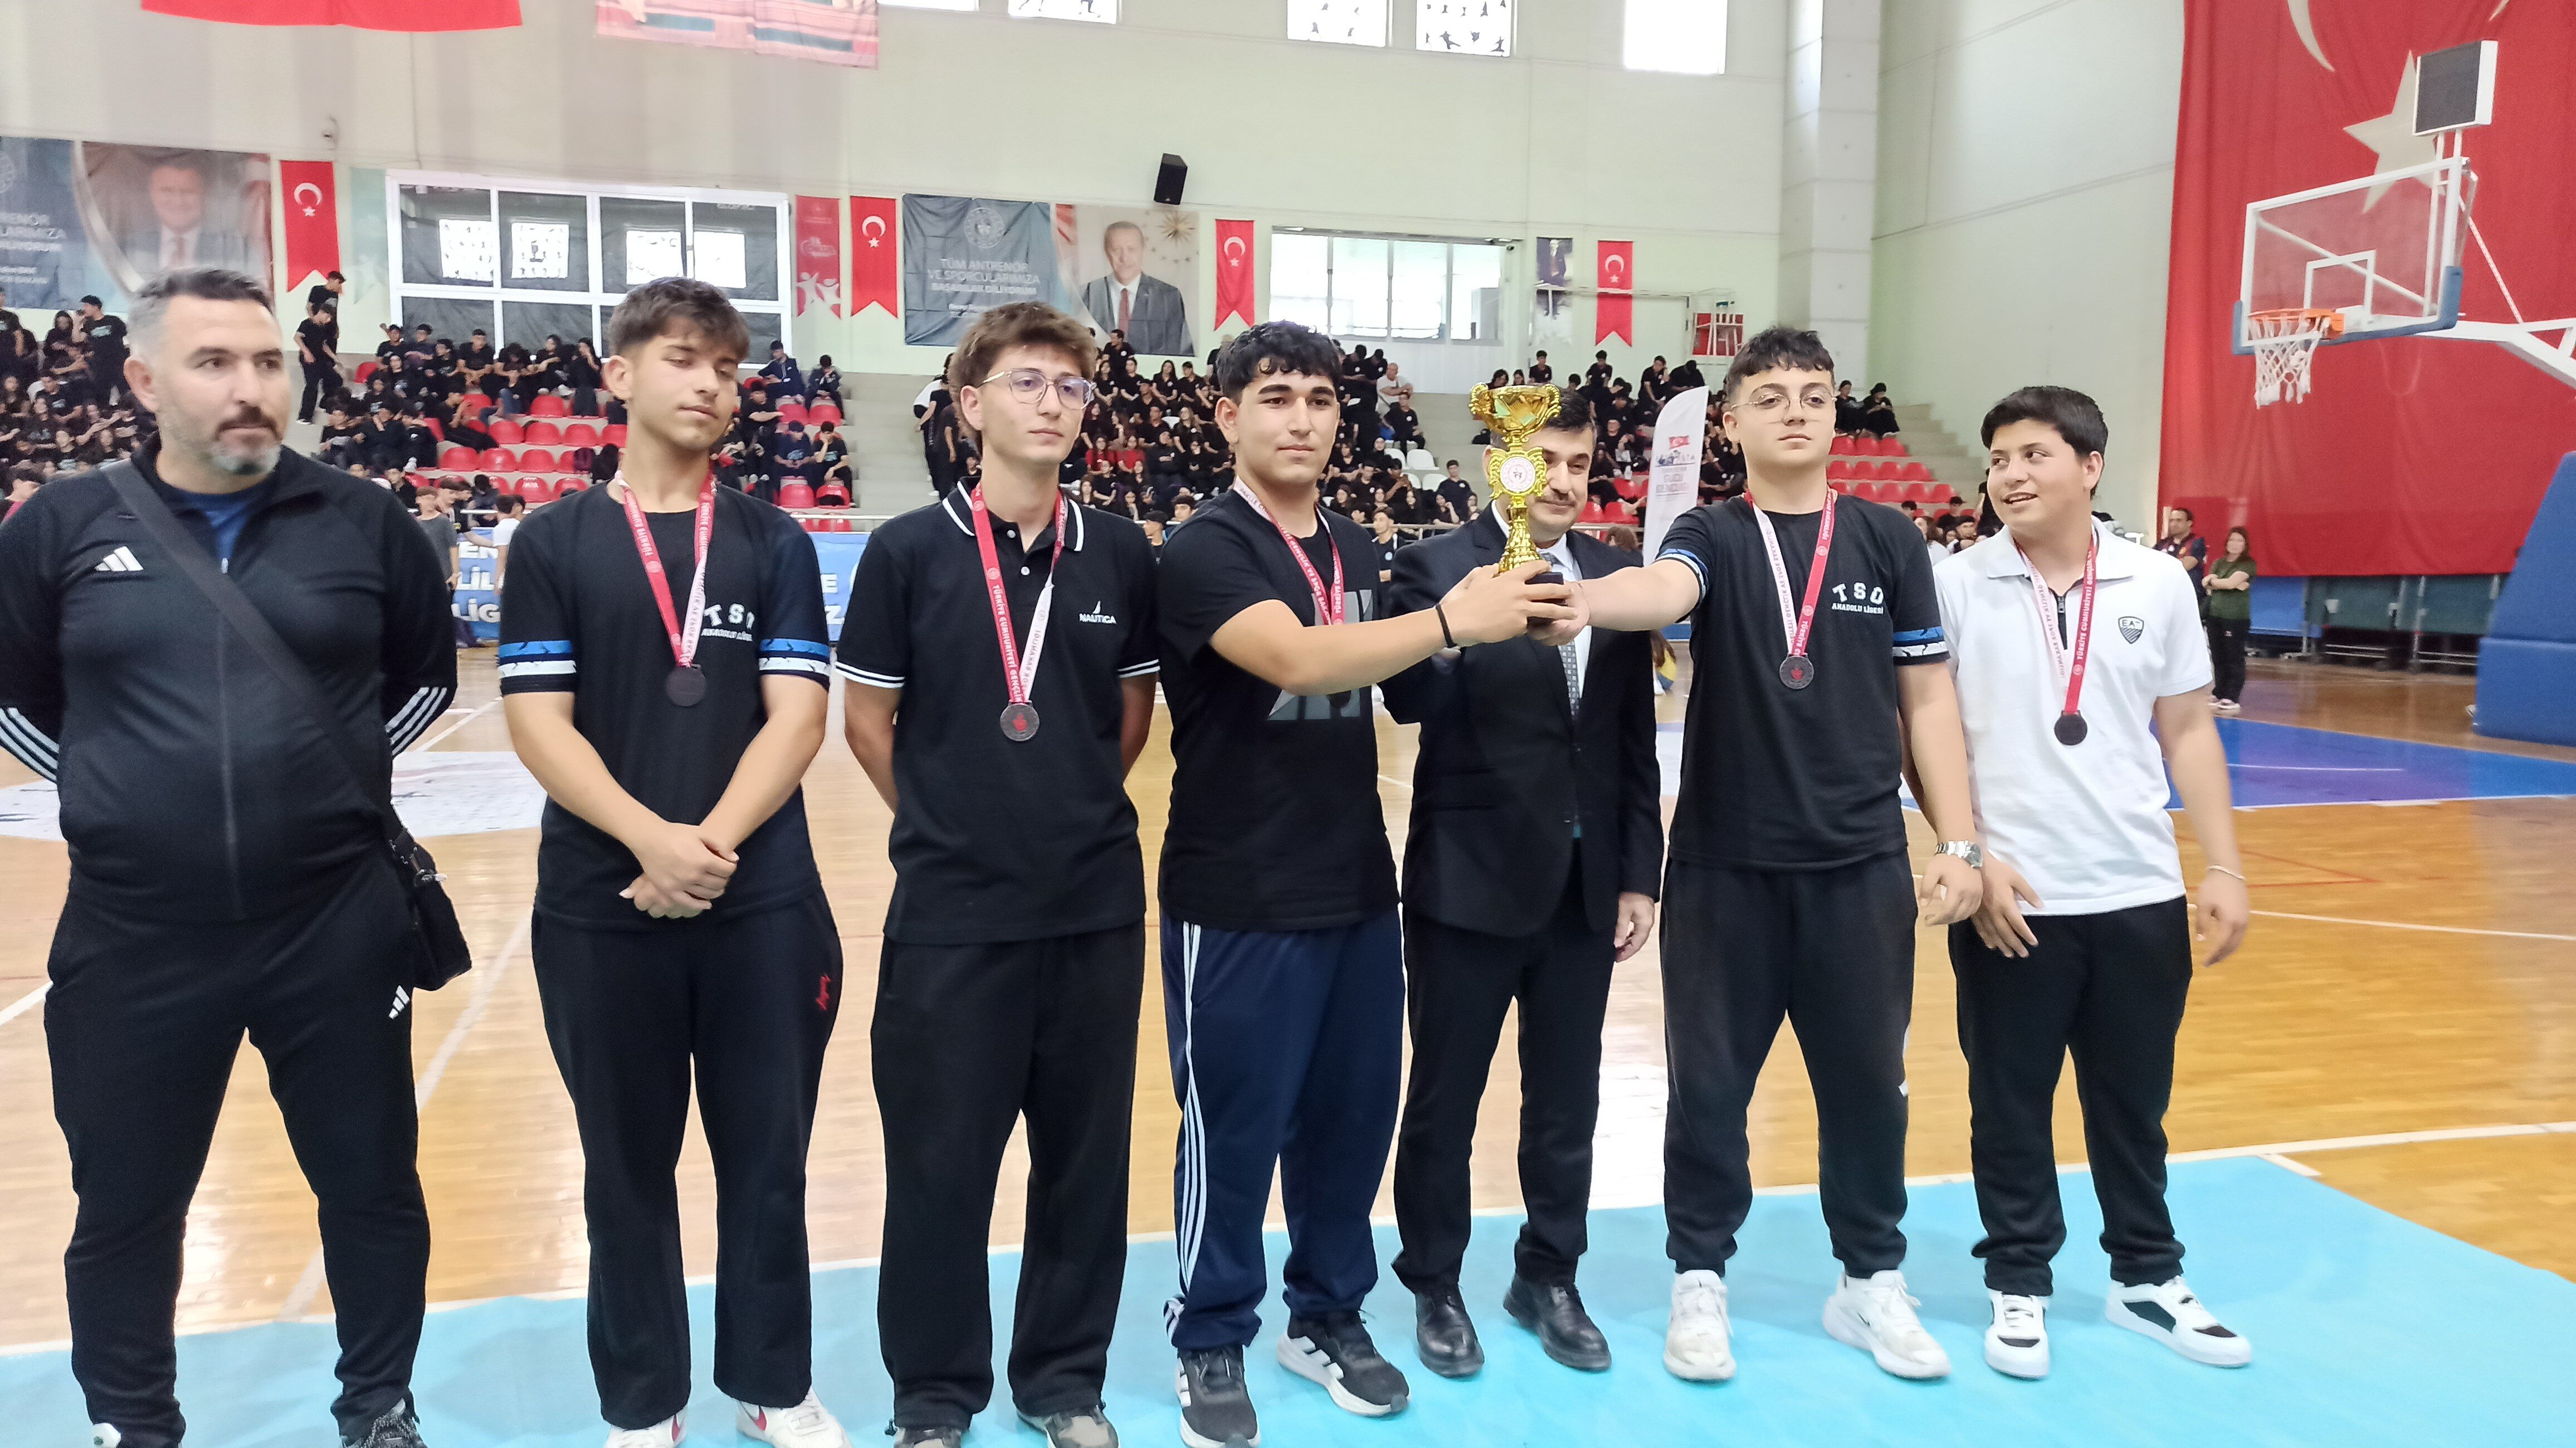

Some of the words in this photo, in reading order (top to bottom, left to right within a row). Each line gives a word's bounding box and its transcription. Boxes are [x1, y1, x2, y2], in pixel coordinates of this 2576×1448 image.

[993, 584, 1006, 616] TÜRKİYE
[1831, 603, 1863, 612] ANADOLU
[1079, 613, 1117, 624] NAUTICA
